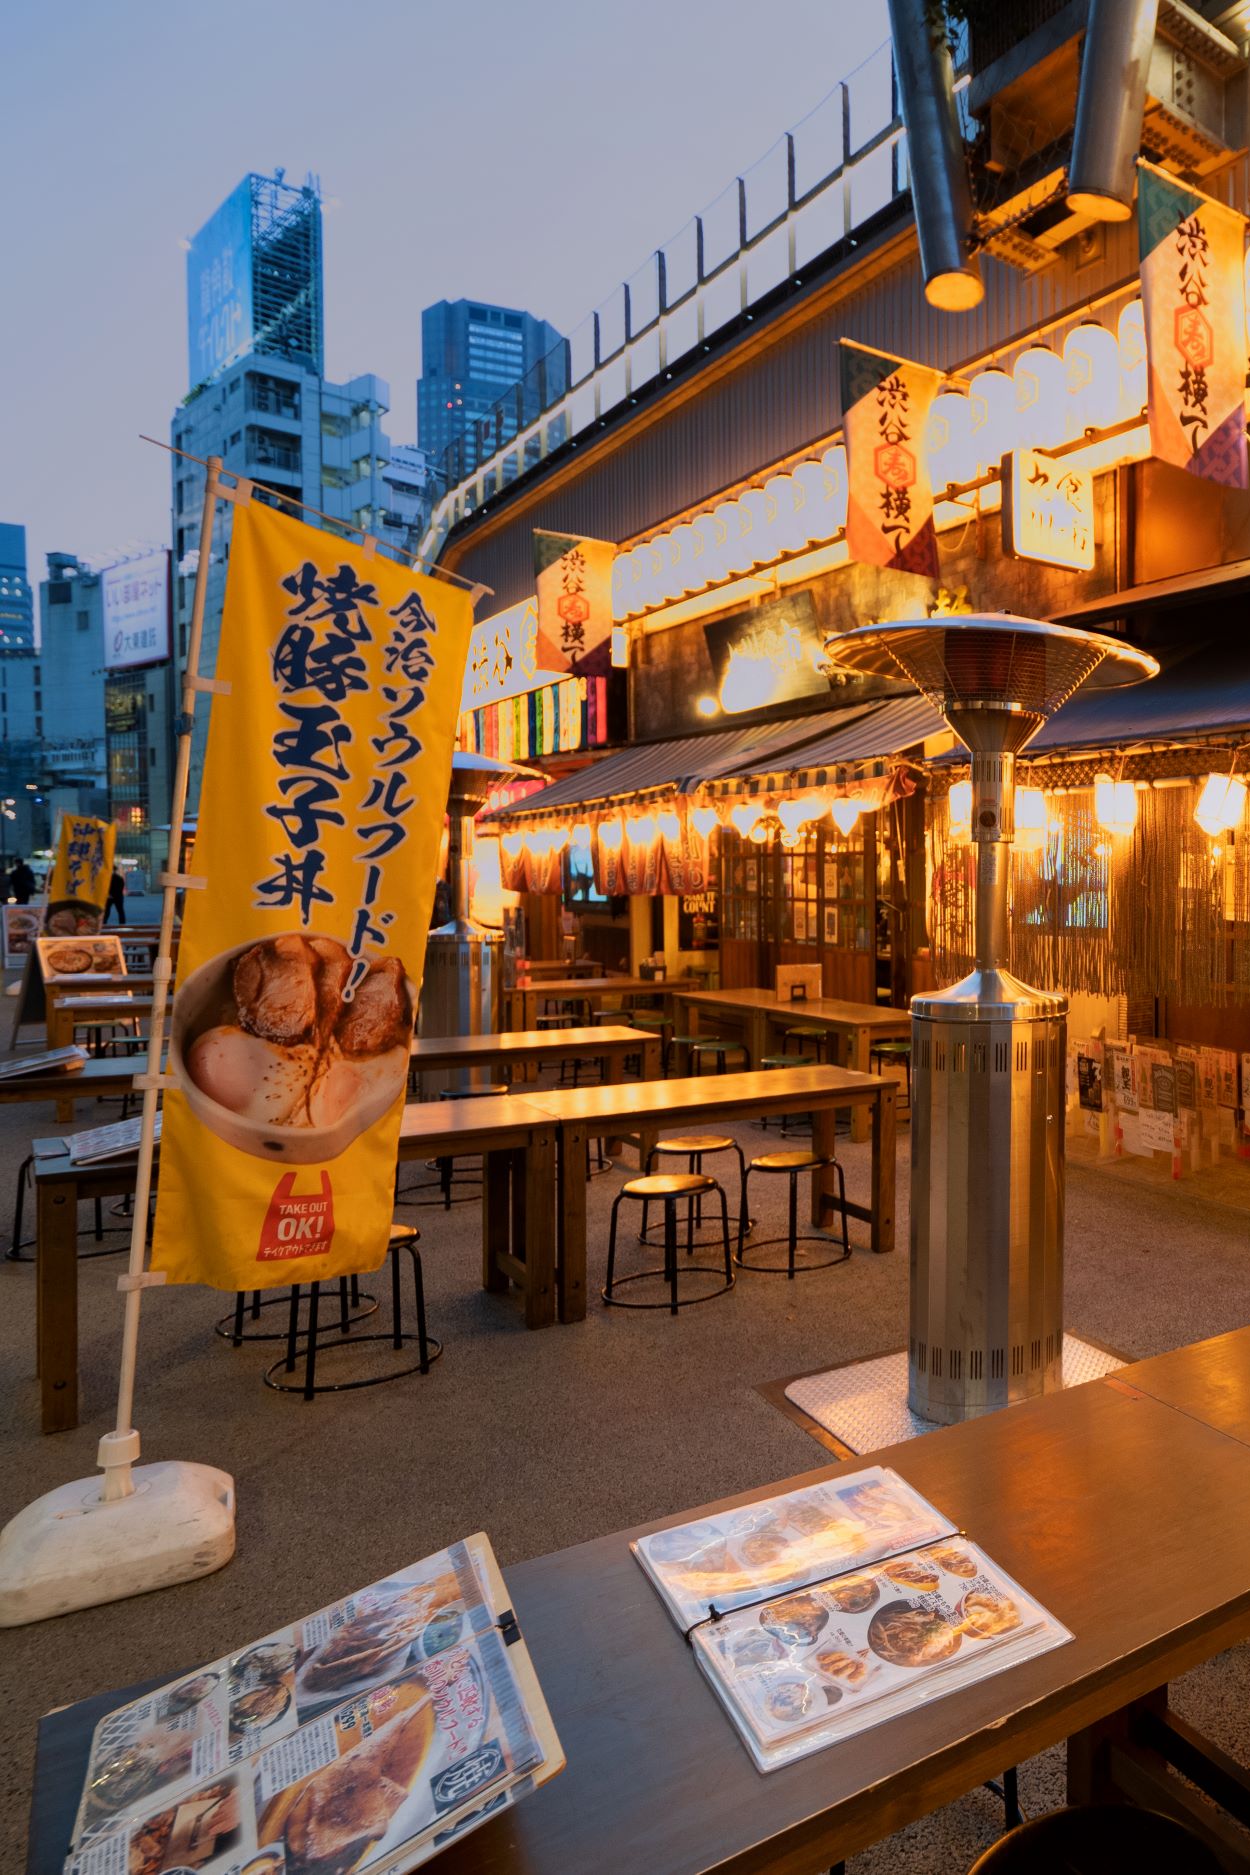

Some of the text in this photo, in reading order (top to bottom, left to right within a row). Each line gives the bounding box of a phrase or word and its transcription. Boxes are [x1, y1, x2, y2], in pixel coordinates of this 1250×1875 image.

[253, 561, 378, 924] 焼豚玉子丼
[280, 1201, 328, 1215] TAKE OUT
[278, 1216, 324, 1241] OK!
